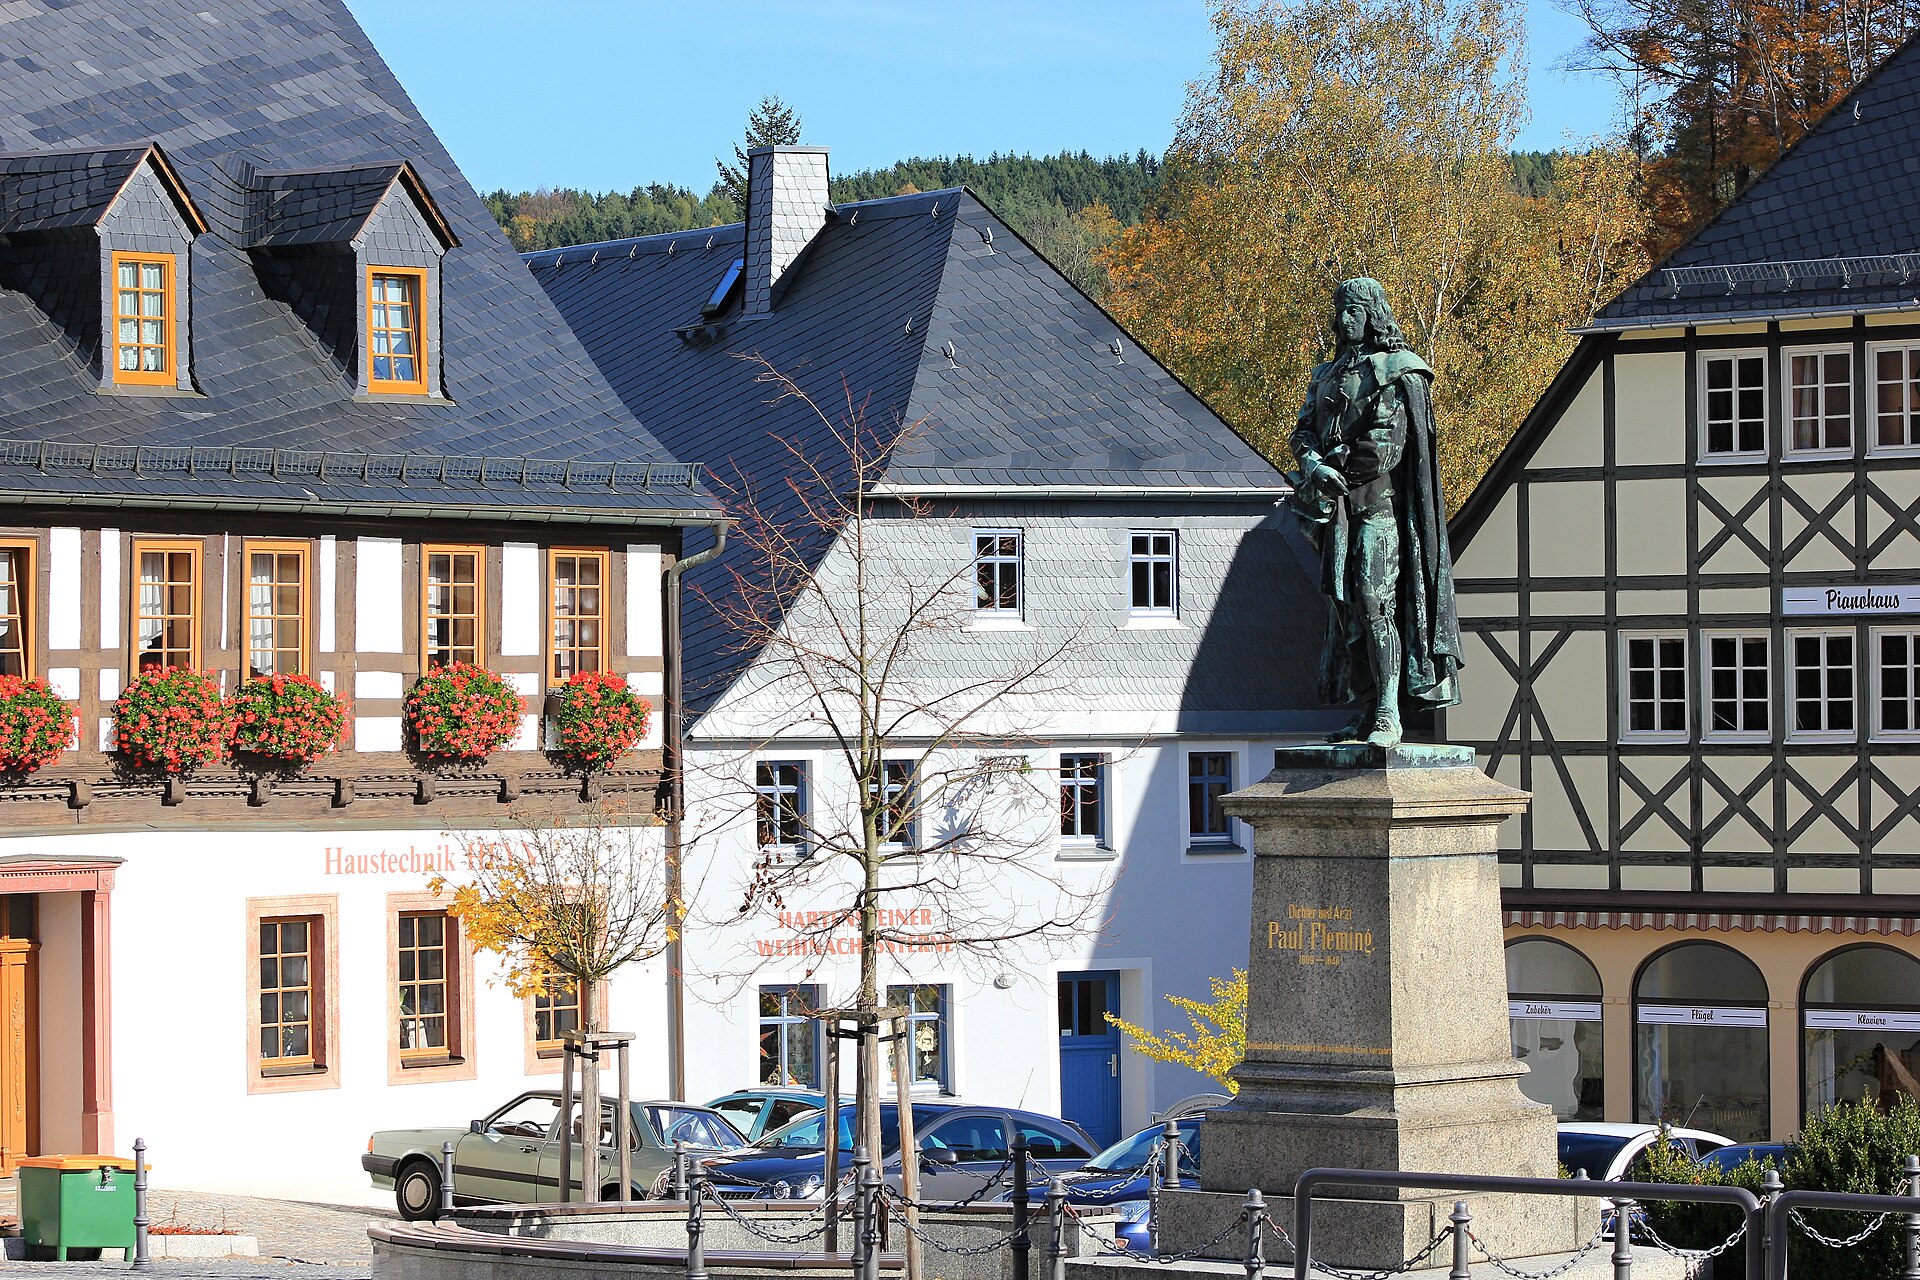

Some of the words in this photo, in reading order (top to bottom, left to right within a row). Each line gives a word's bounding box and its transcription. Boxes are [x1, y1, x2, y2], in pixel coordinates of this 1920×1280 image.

[1825, 588, 1900, 611] Pianohaus
[324, 844, 456, 875] Haustechnik
[778, 908, 933, 929] HARTENSEINER
[1288, 904, 1317, 919] Dichter
[1318, 905, 1332, 919] und
[1333, 905, 1353, 920] Arzt
[1268, 921, 1303, 949] Paul
[757, 935, 955, 957] WEIHNACHSSTERNE
[1691, 1009, 1715, 1022] Flügel
[1857, 1014, 1887, 1026] Klaviere
